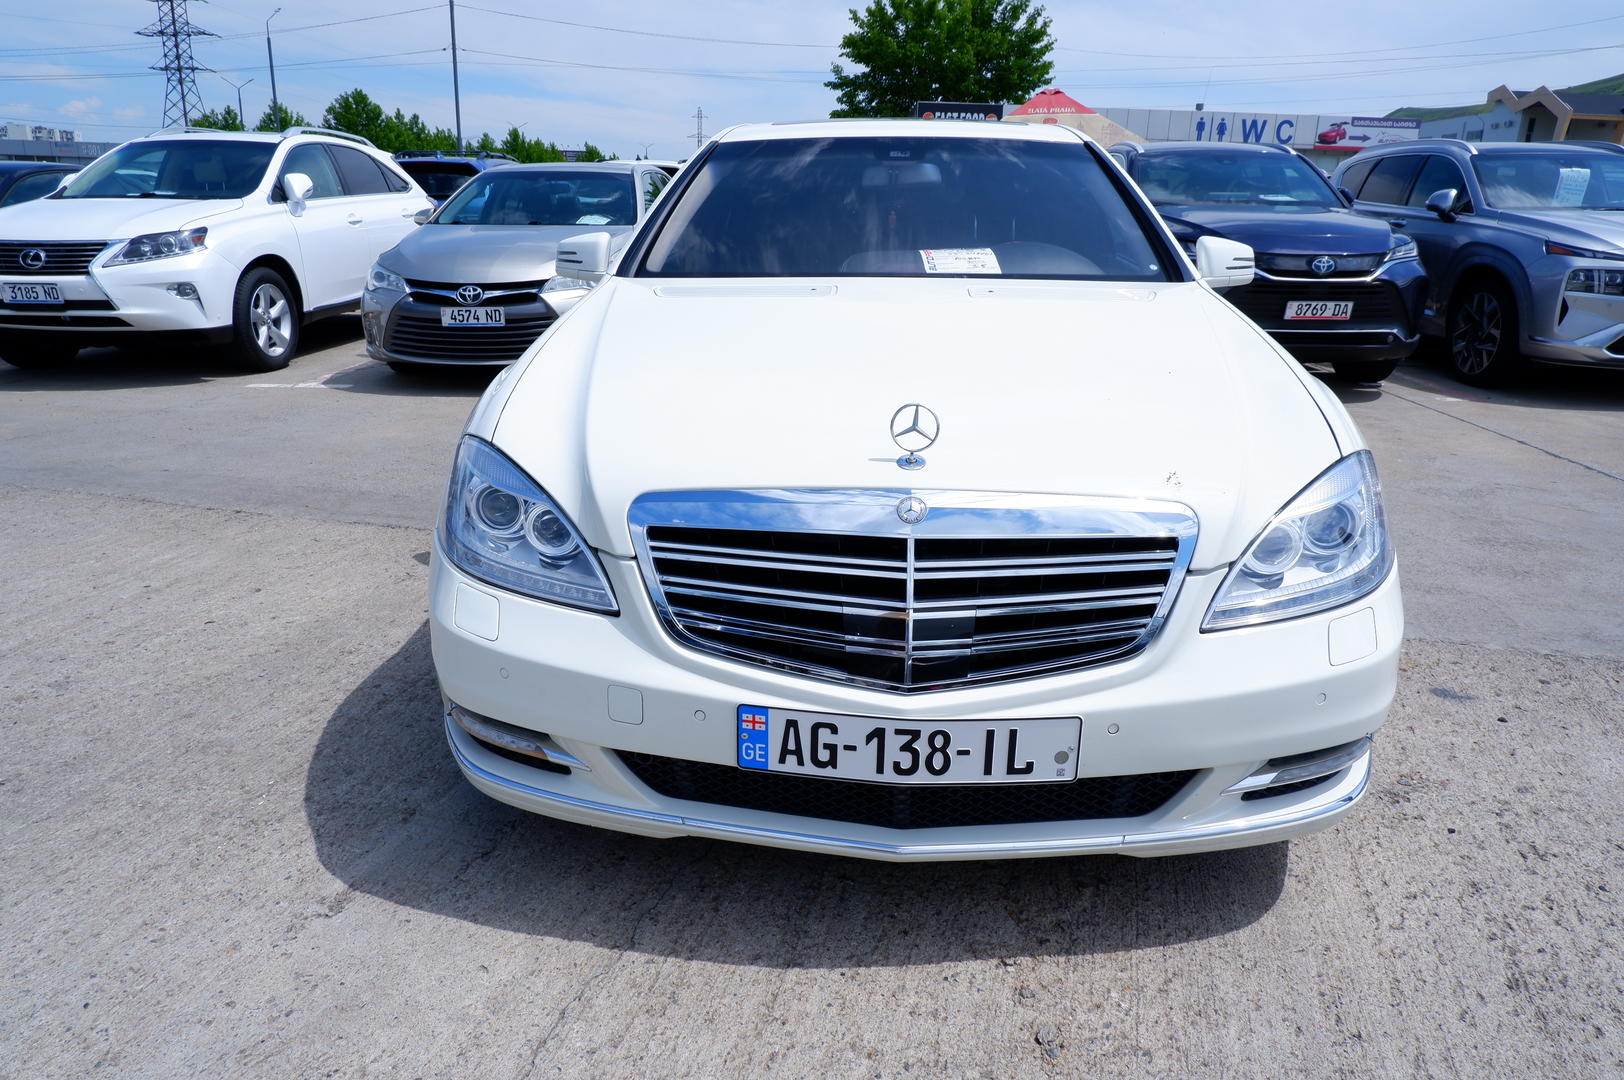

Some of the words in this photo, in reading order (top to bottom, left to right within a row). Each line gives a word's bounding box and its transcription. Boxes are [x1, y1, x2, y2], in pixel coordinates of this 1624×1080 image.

[9, 285, 39, 300] 3185
[42, 286, 60, 300] ND
[450, 309, 480, 323] 4574
[485, 309, 502, 323] ND
[1296, 303, 1328, 316] 8769
[1332, 304, 1349, 316] DA
[742, 743, 766, 762] GE
[778, 718, 1034, 777] AG-138-IL
